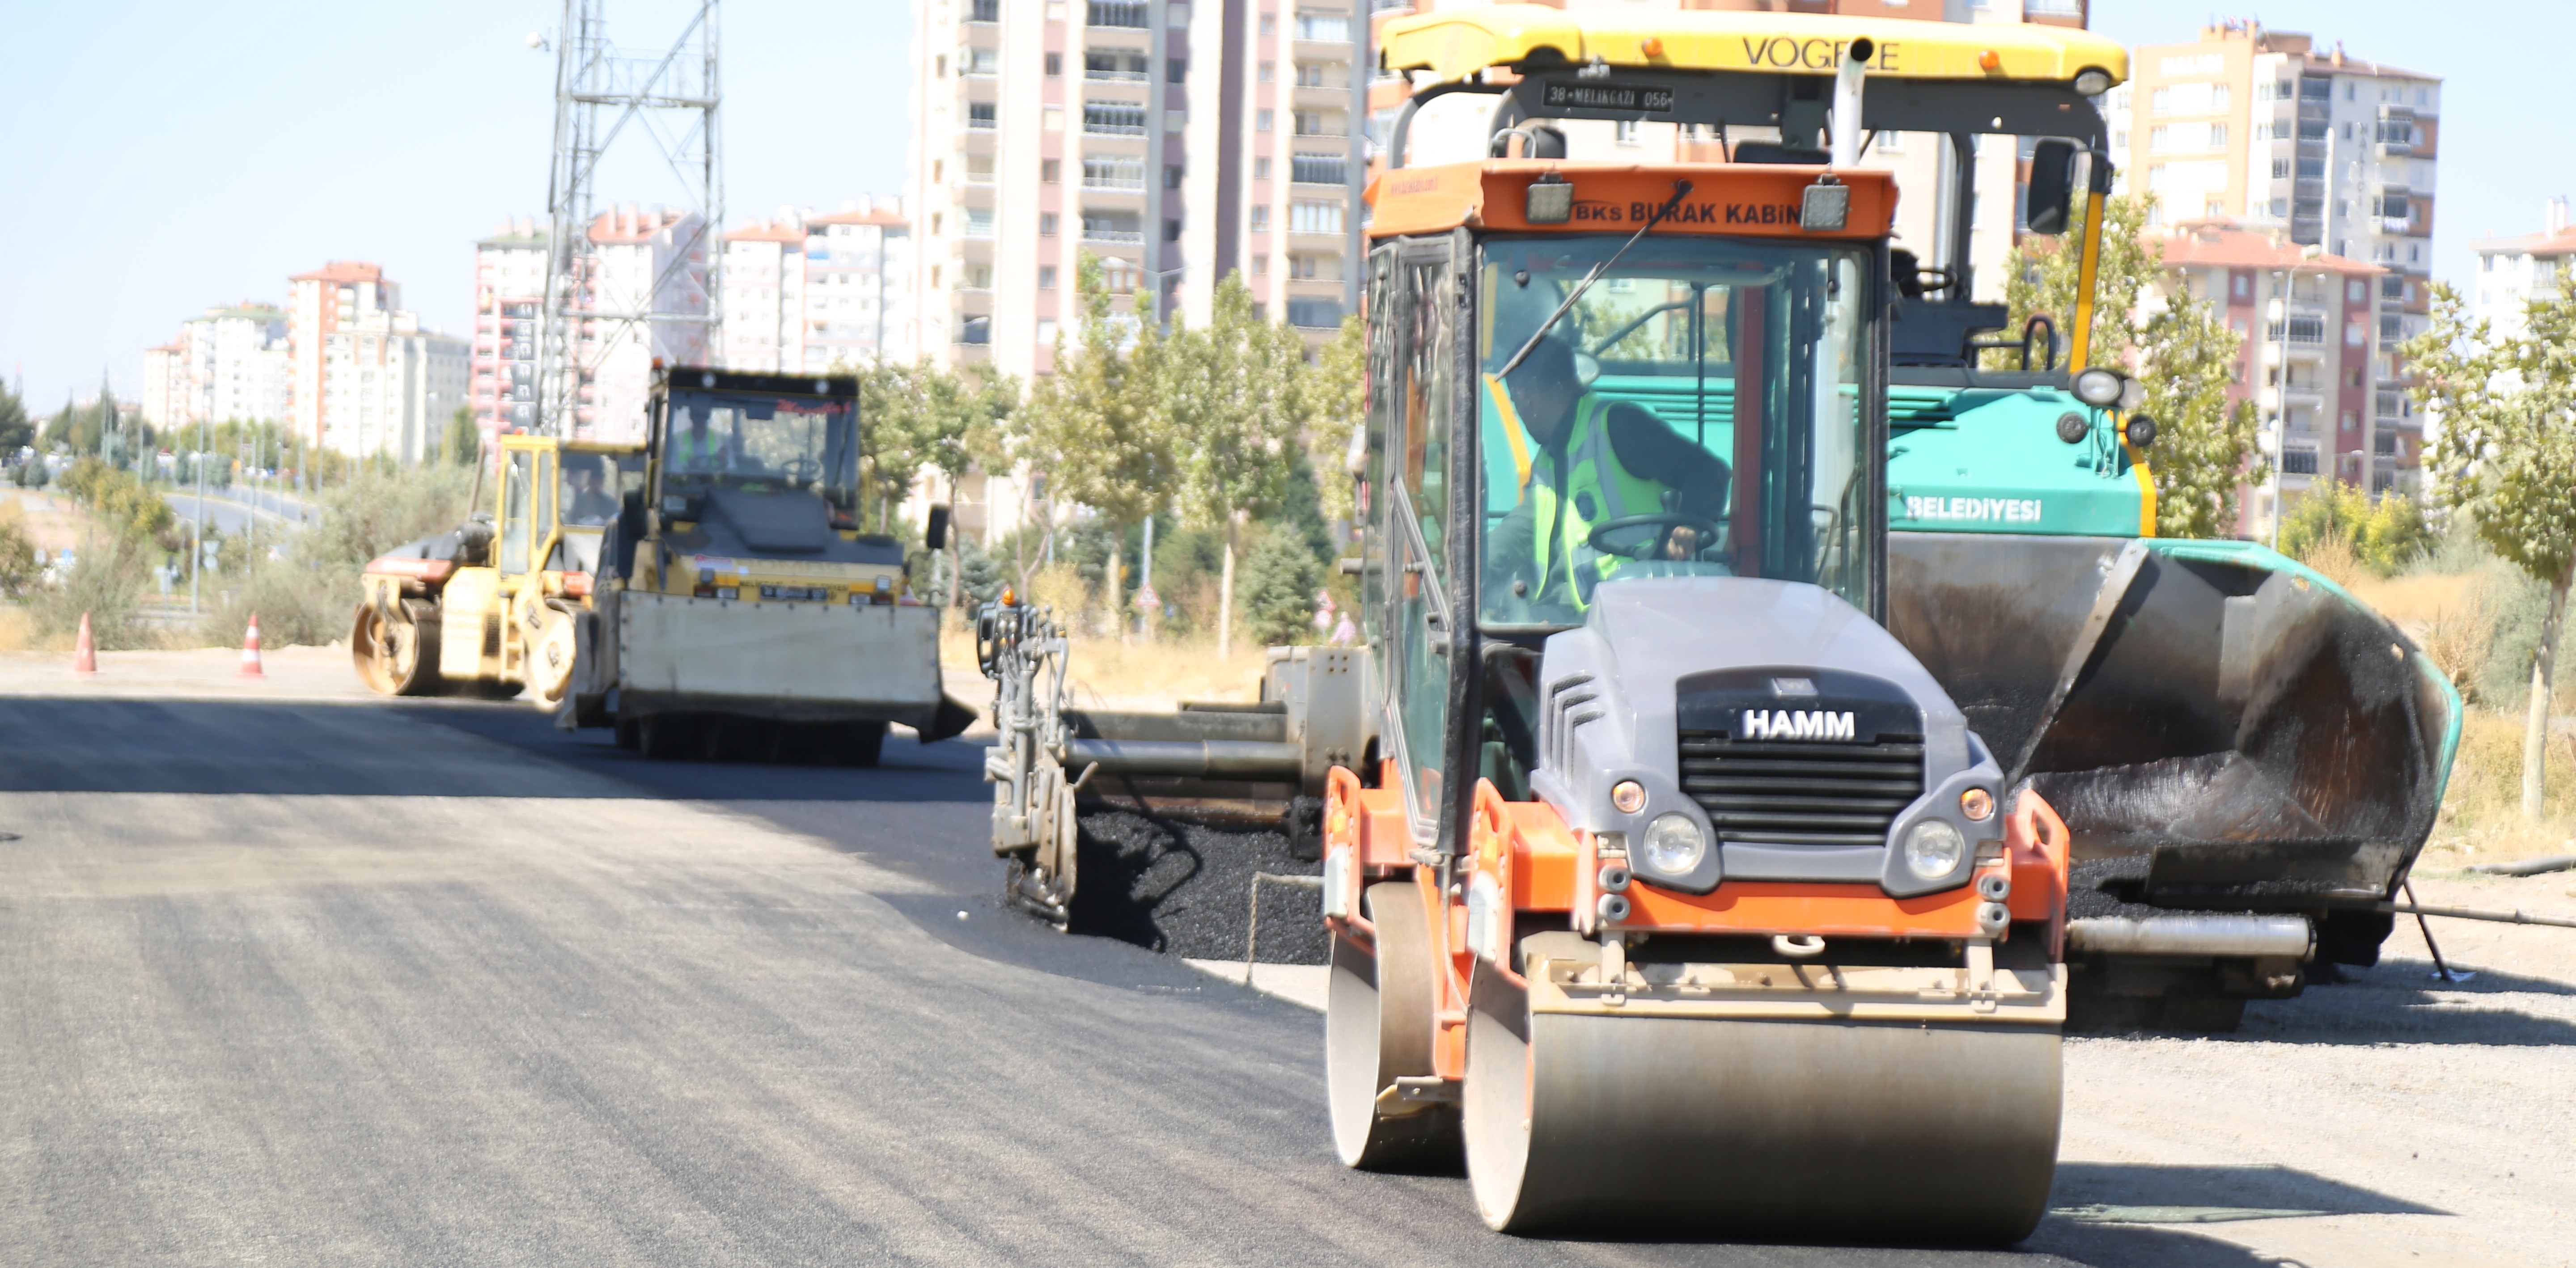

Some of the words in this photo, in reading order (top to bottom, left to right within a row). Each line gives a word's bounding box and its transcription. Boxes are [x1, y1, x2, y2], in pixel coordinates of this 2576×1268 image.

[1550, 86, 1566, 101] 38
[1644, 92, 1668, 106] 056
[1576, 205, 1623, 221] BKS
[1745, 709, 1855, 739] HAMM
